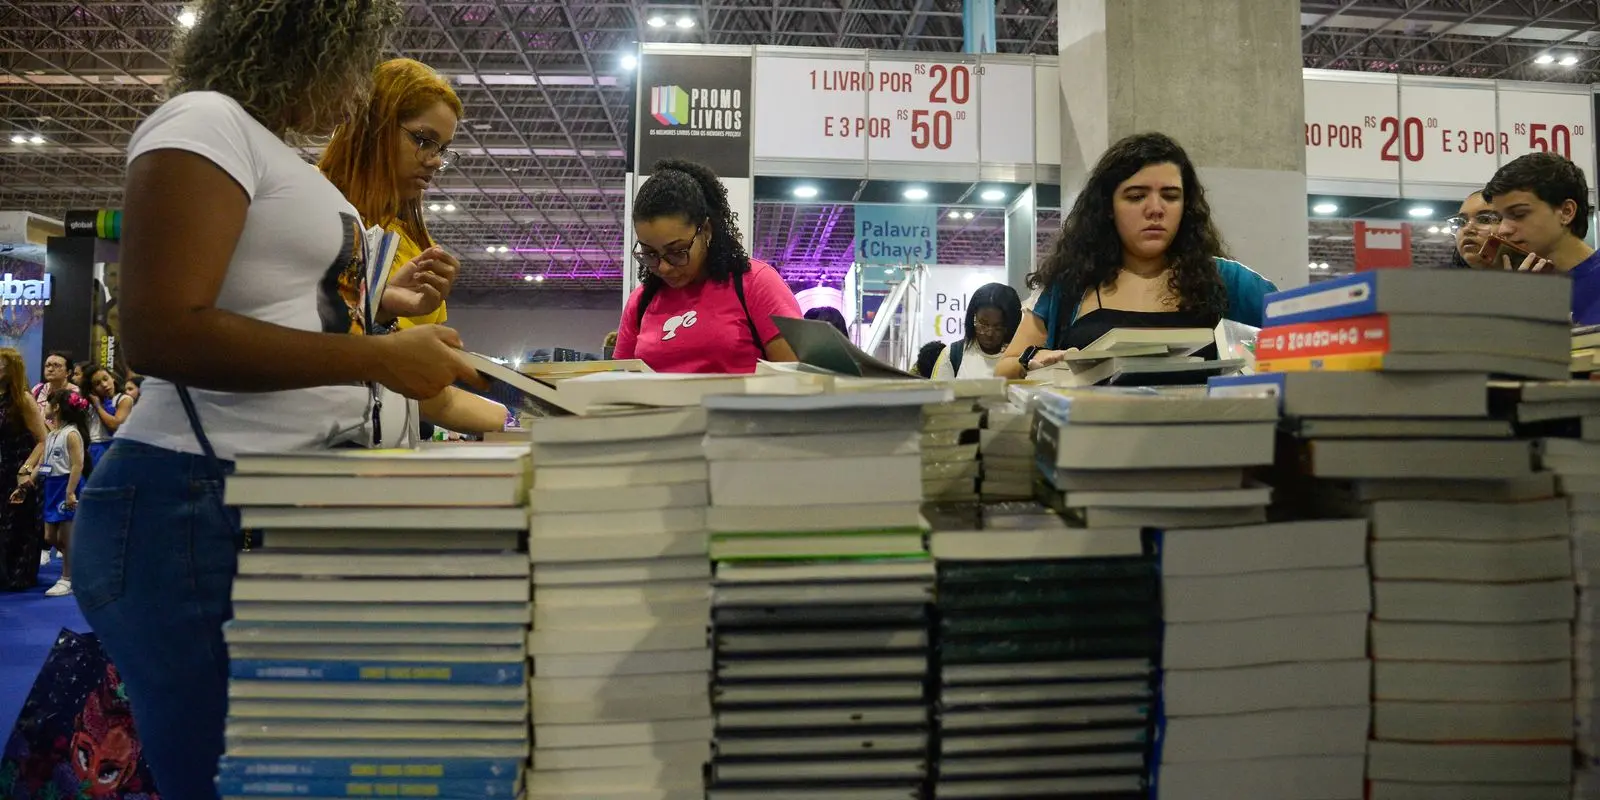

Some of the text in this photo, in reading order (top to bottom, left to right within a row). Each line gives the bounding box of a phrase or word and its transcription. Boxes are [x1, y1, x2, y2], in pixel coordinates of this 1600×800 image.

[809, 70, 816, 90] 1
[823, 70, 874, 92] LIVRO
[879, 72, 912, 93] POR
[929, 64, 970, 104] 20
[691, 88, 742, 109] PROMO
[690, 109, 742, 130] LIVROS
[824, 116, 834, 137] E
[839, 117, 850, 138] 3
[855, 118, 891, 139] POR
[911, 109, 952, 150] 50
[1328, 124, 1362, 149] POR
[1380, 116, 1424, 162] 20
[1442, 130, 1452, 152] E
[1458, 130, 1468, 153] 3
[1474, 132, 1509, 155] POR
[1529, 123, 1571, 161] 50
[862, 220, 930, 237] Palavra
[0, 272, 52, 300] bal
